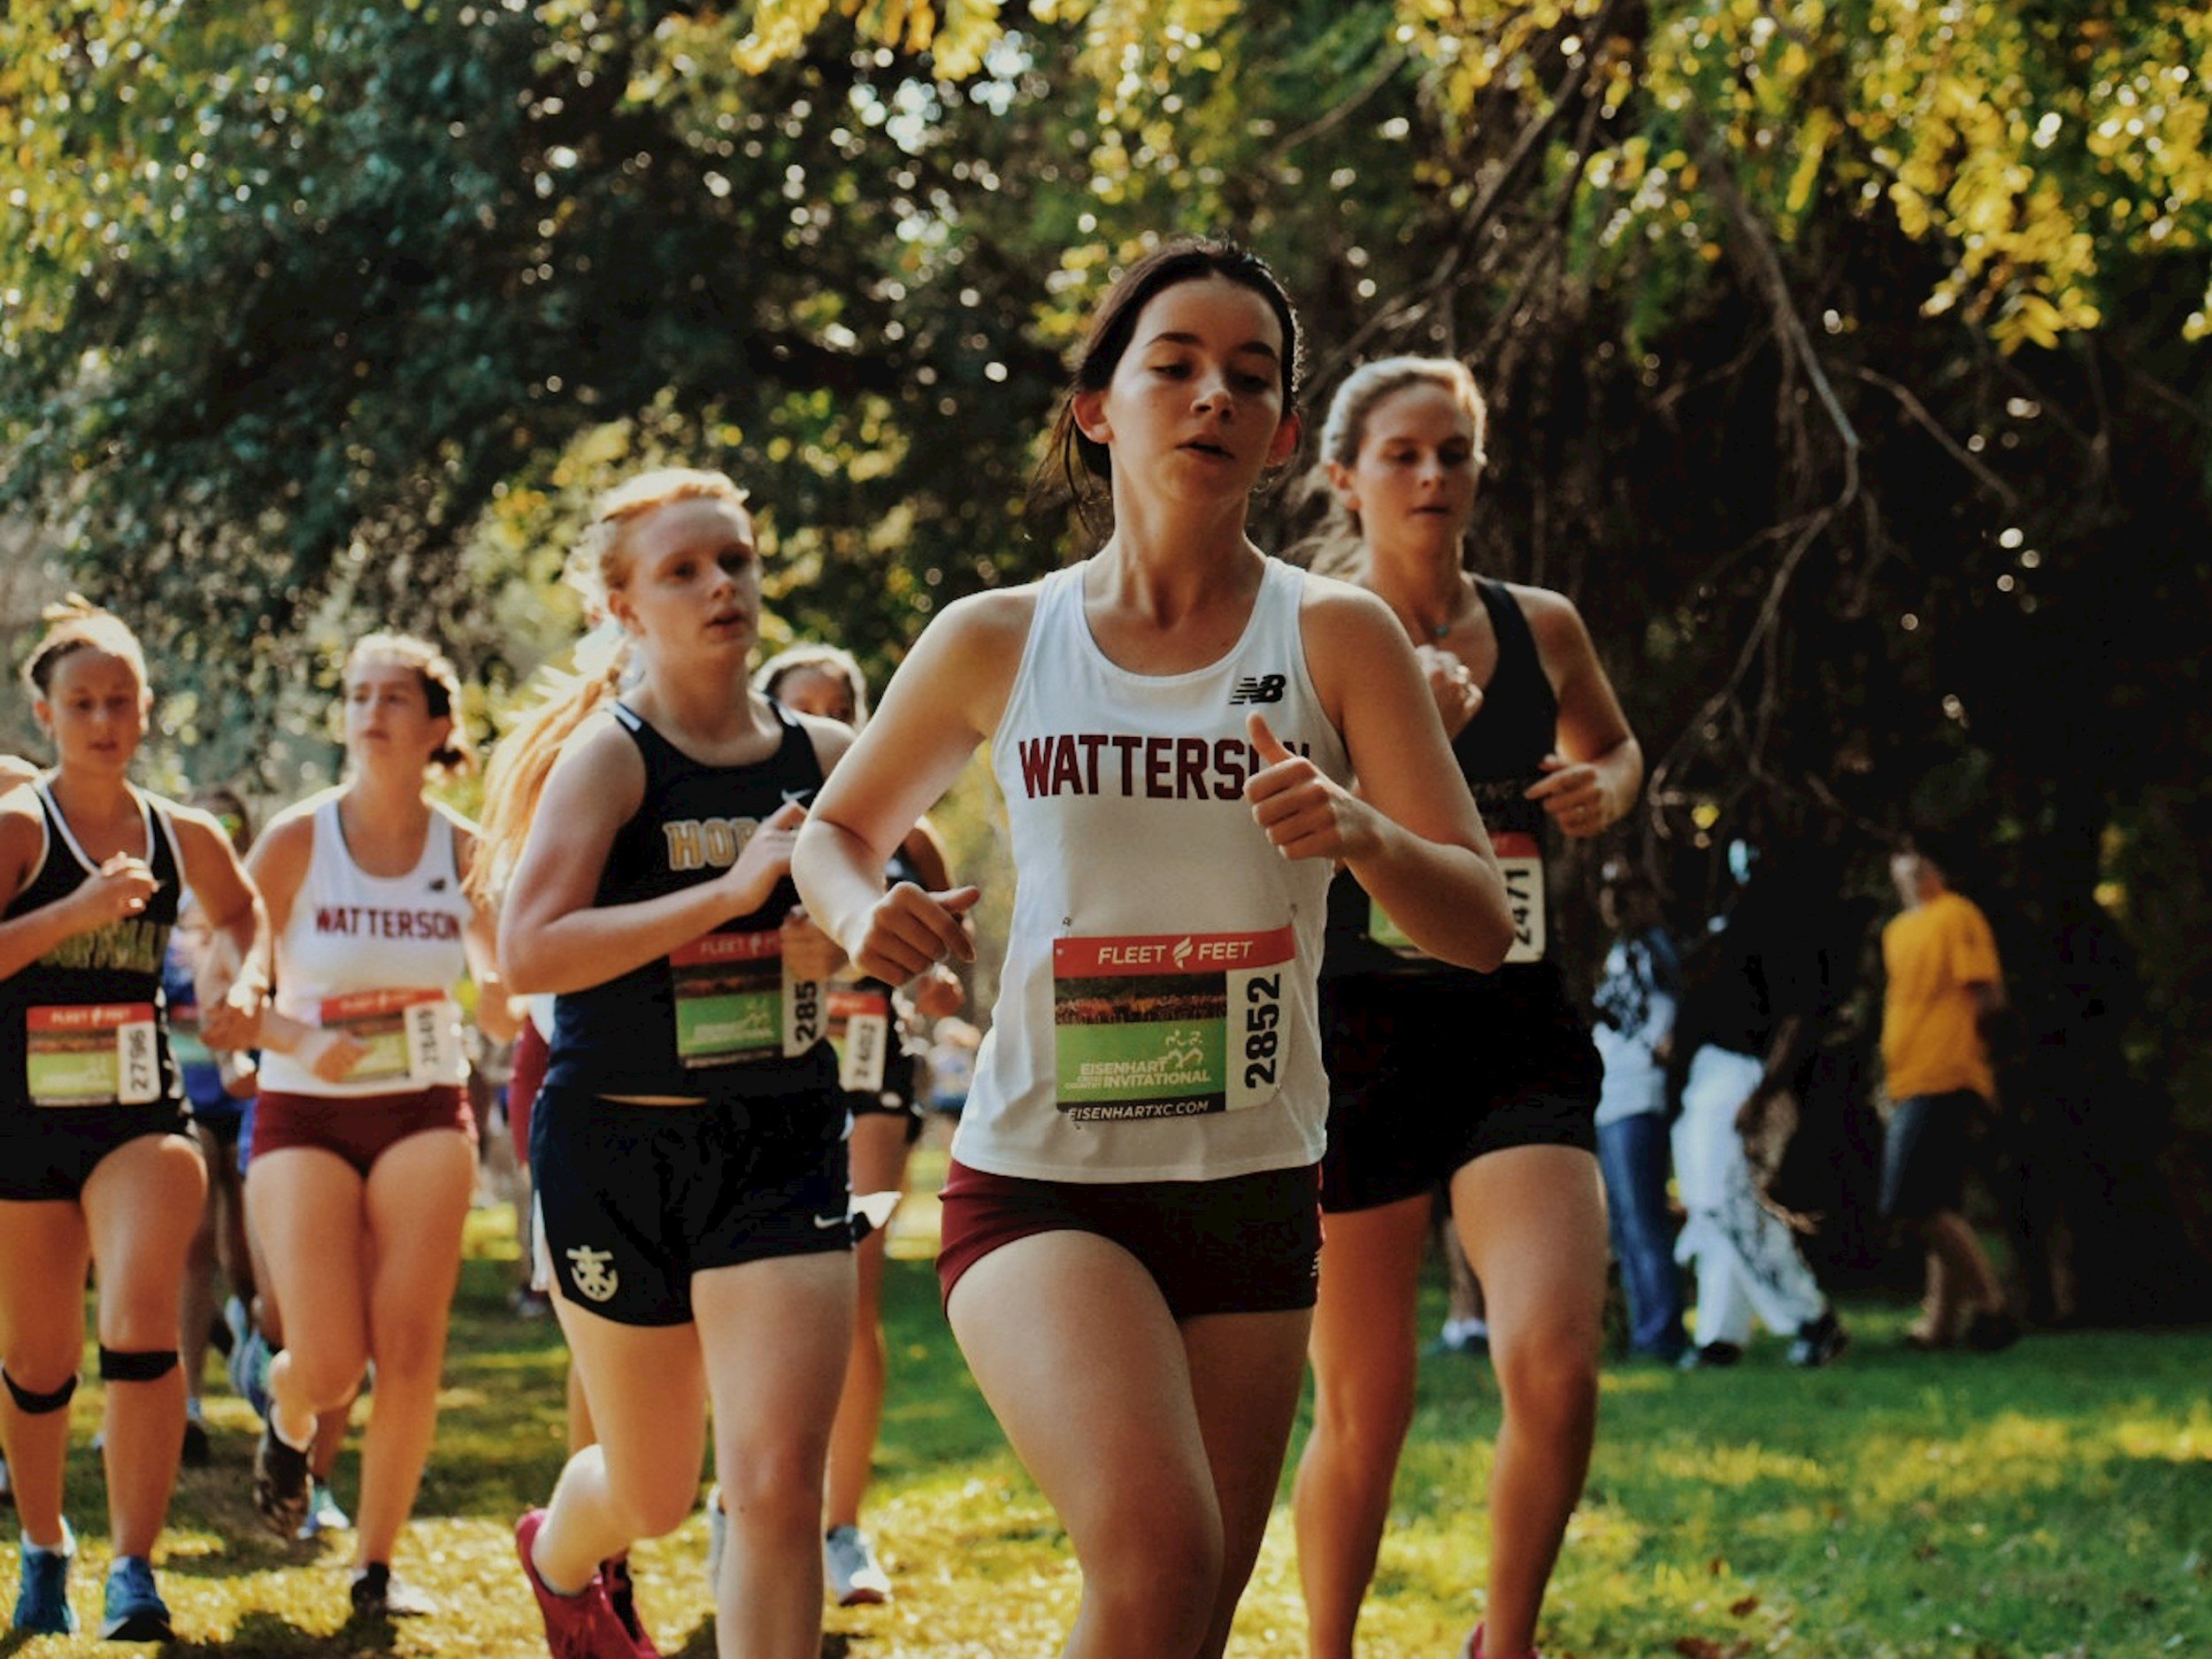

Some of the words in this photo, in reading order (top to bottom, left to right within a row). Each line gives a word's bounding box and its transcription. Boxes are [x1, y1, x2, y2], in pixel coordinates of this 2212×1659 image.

[316, 908, 460, 940] WATTERSON
[1097, 944, 1167, 965] FLEET
[1197, 941, 1254, 961] FEET
[795, 979, 818, 1042] 285
[1244, 972, 1280, 1088] 2852
[1080, 1058, 1168, 1076] EISENHART
[1105, 1068, 1212, 1088] INVITATIONAL
[1067, 1100, 1210, 1122] EISENHARTXC.COM
